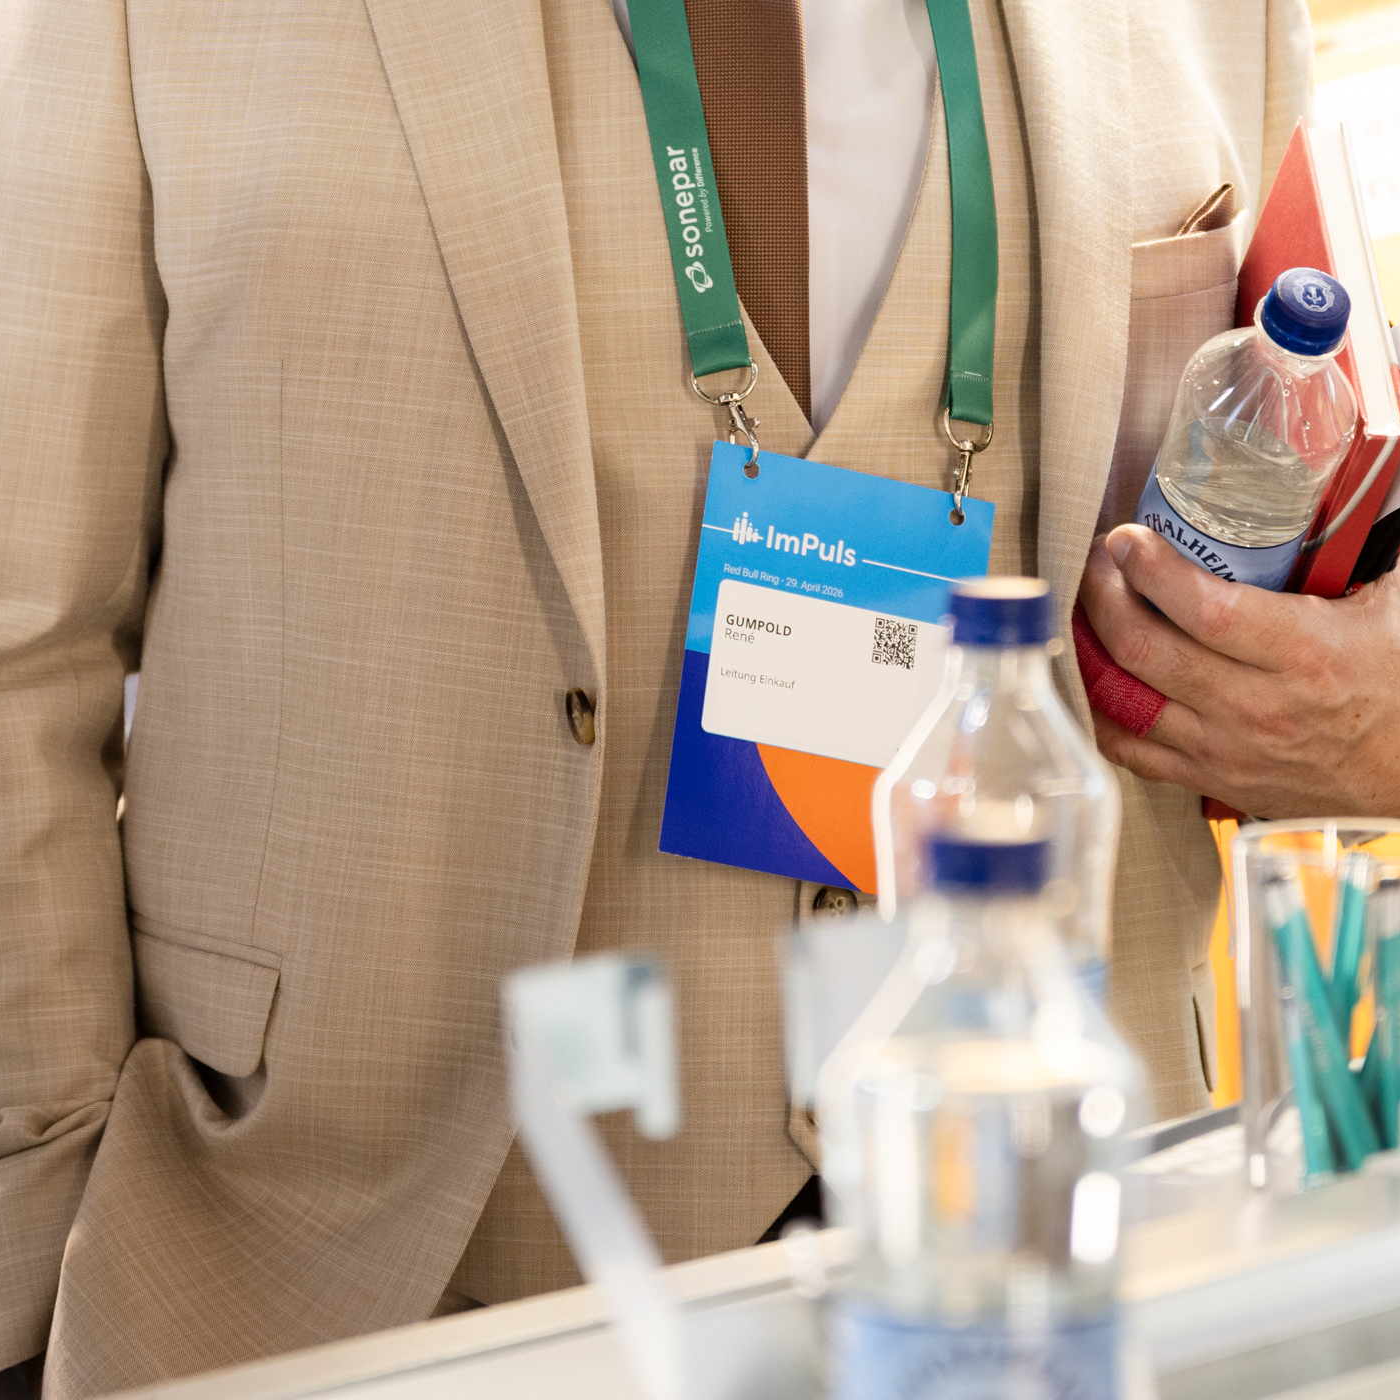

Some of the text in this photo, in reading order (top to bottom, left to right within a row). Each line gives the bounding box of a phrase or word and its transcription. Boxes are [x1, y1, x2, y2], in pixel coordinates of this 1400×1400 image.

[666, 146, 704, 258] sonepar
[692, 147, 714, 233] Powered by Difference
[766, 525, 856, 567] ImPuls
[723, 563, 741, 576] Red
[742, 567, 759, 579] Bull
[760, 571, 780, 586] Ring
[786, 577, 799, 588] 29.
[800, 581, 821, 593] April
[822, 585, 844, 598] 2026
[724, 627, 755, 644] René
[726, 614, 792, 636] GUMPOLD
[720, 667, 796, 689] Leitung Einkauf
